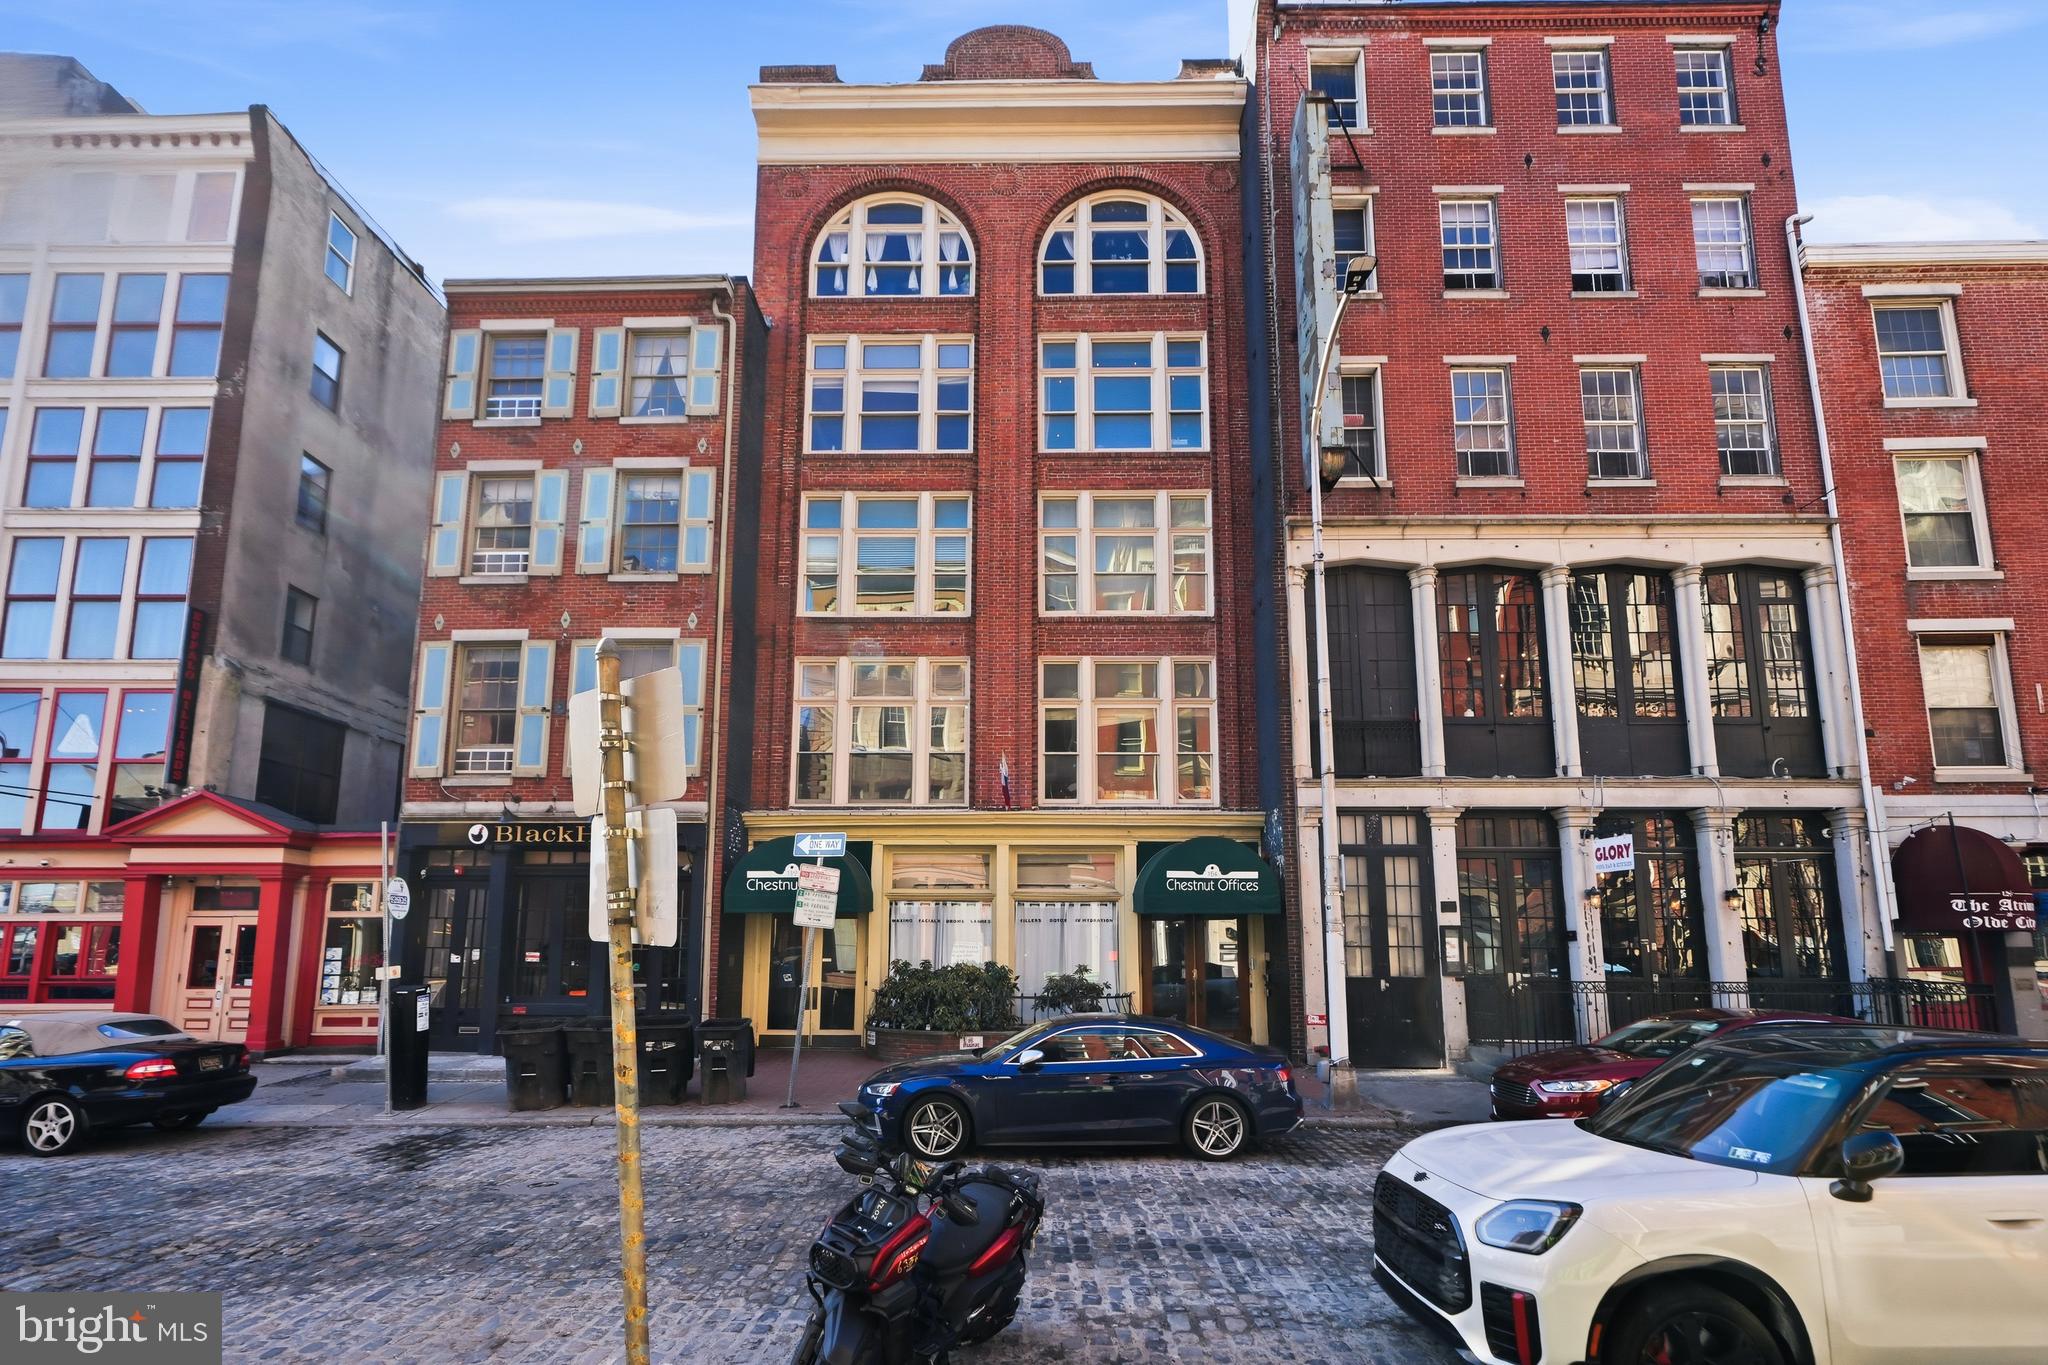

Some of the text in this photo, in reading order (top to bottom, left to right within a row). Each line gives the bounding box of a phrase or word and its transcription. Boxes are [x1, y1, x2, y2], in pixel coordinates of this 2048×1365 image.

[809, 840, 840, 849] ONE WAY
[1595, 843, 1631, 861] GLORY
[746, 879, 798, 891] Chestnu
[1166, 878, 1259, 891] Chestnut Offices
[1950, 899, 1990, 913] The
[1962, 915, 2009, 929] Olde
[870, 1198, 887, 1220] 2024
